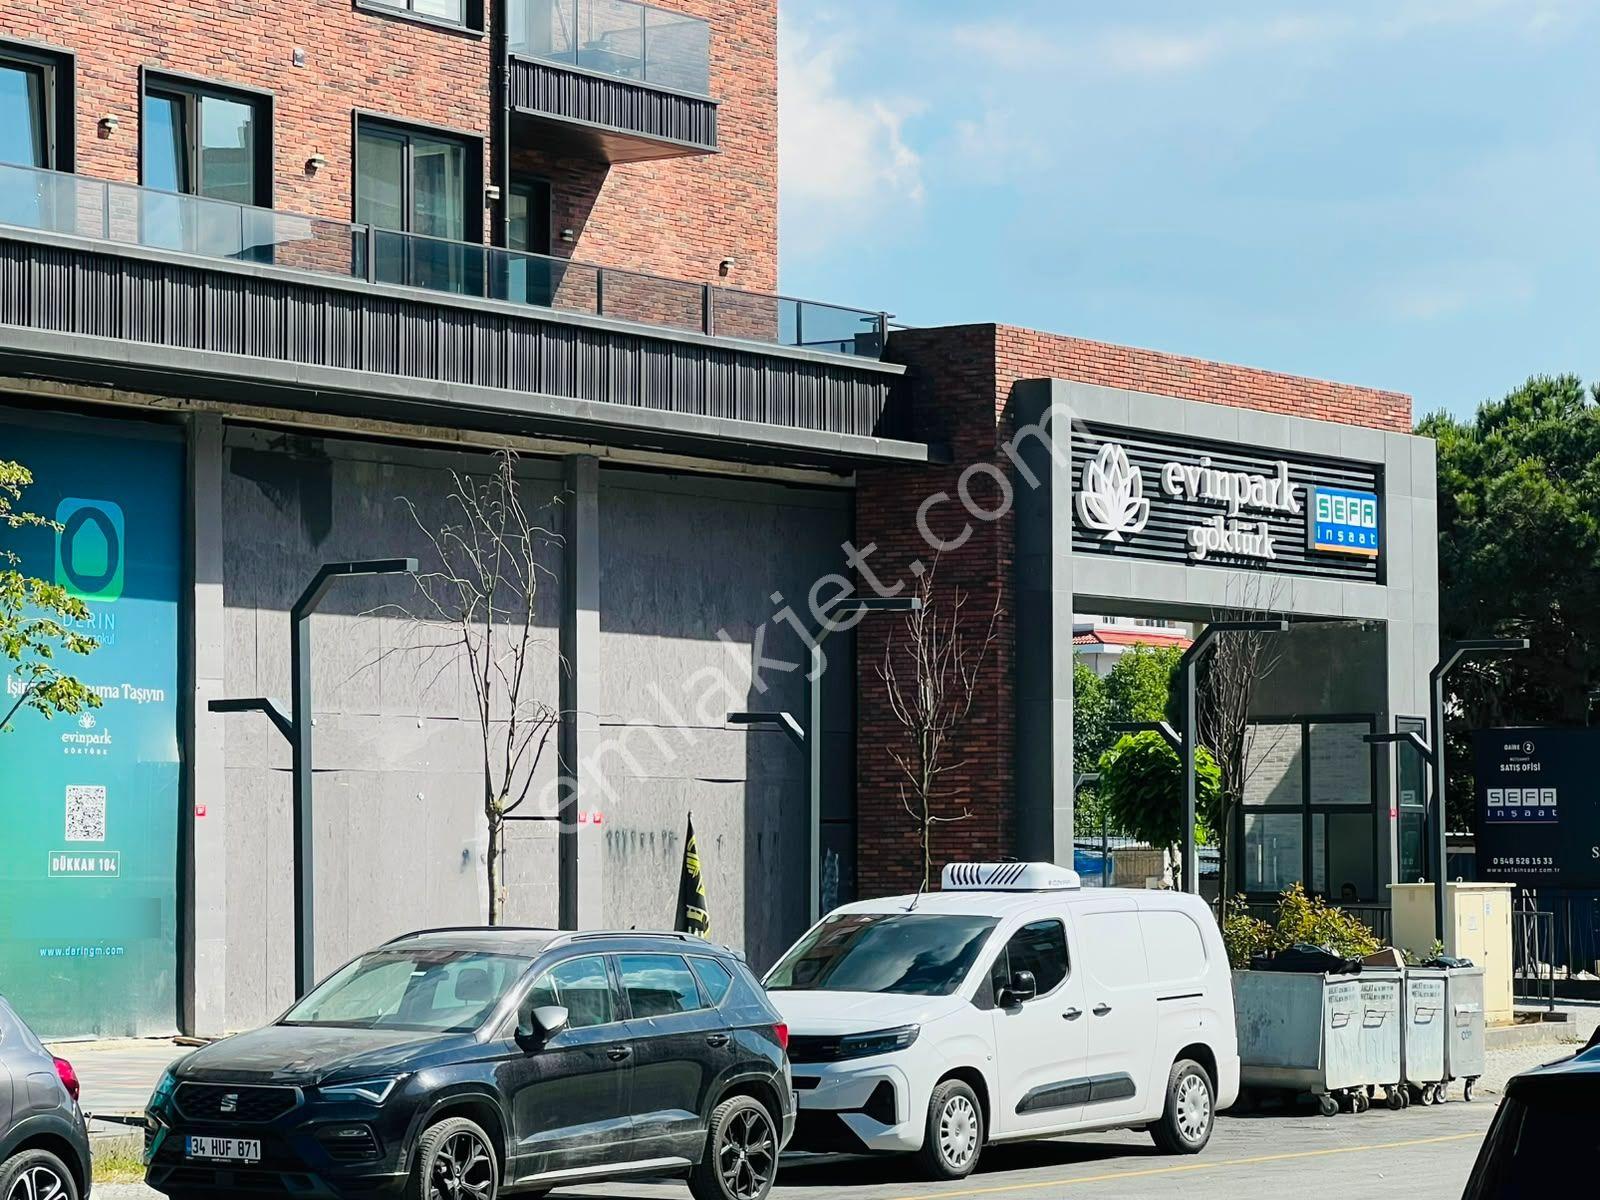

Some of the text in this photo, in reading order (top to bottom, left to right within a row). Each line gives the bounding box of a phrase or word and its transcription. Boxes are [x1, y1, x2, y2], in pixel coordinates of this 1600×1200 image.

[1161, 457, 1300, 517] evinpark
[1317, 496, 1375, 526] SEFA
[1187, 515, 1276, 560] göktürk
[121, 684, 164, 704] Taşıyın
[61, 727, 112, 747] evinpark
[1489, 790, 1555, 805] SEFA
[52, 855, 116, 872] DÜKKAN 104
[1543, 857, 1553, 865] 33
[40, 946, 124, 958] www.deringm.com
[192, 1138, 258, 1158] 34 HUF 871
